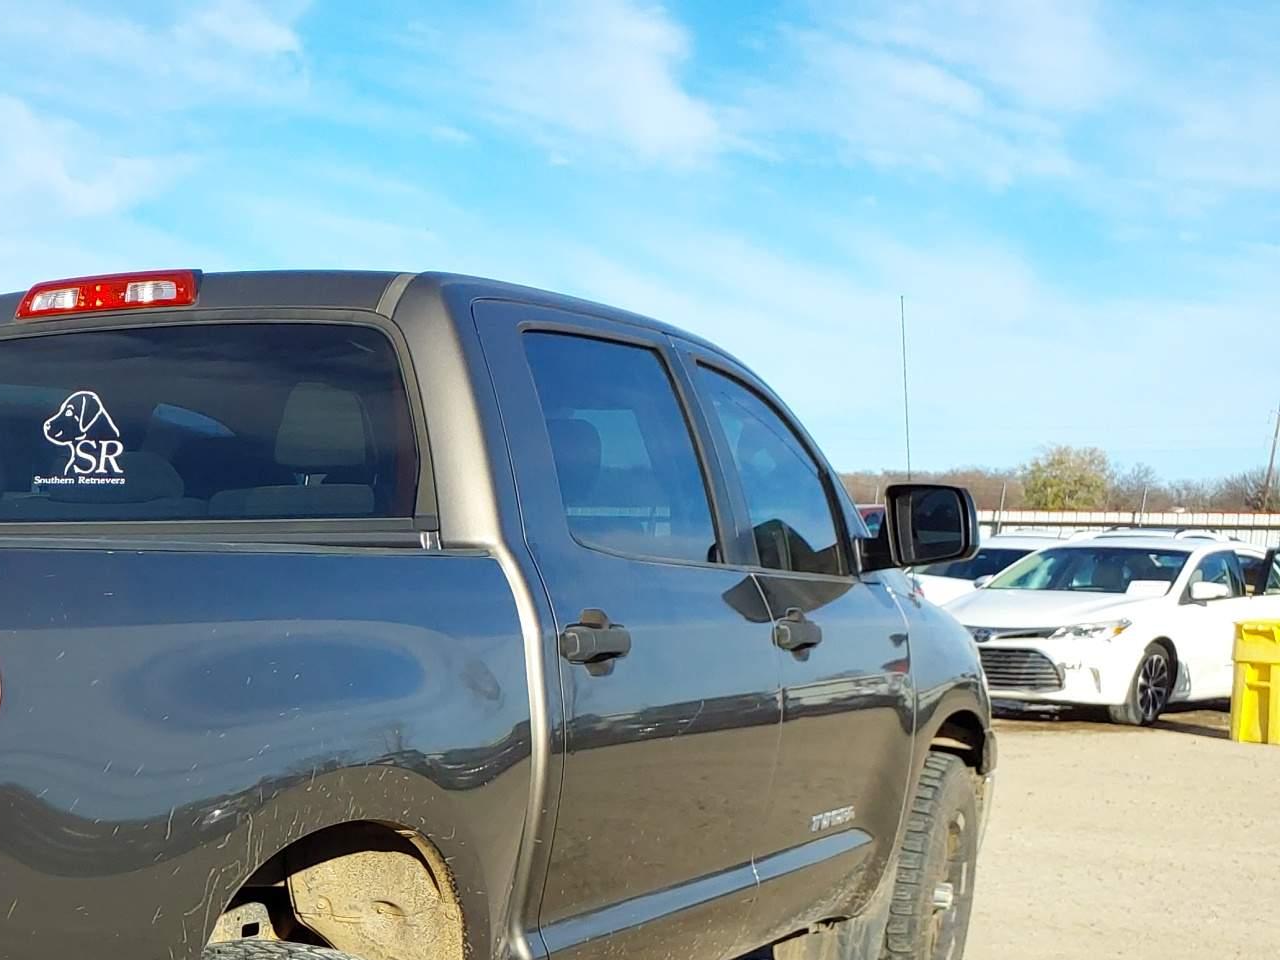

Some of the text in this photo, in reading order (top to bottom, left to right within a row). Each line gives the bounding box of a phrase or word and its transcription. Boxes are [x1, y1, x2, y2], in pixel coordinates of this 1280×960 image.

[73, 439, 124, 474] SR
[33, 475, 126, 485] Southern Retrievers
